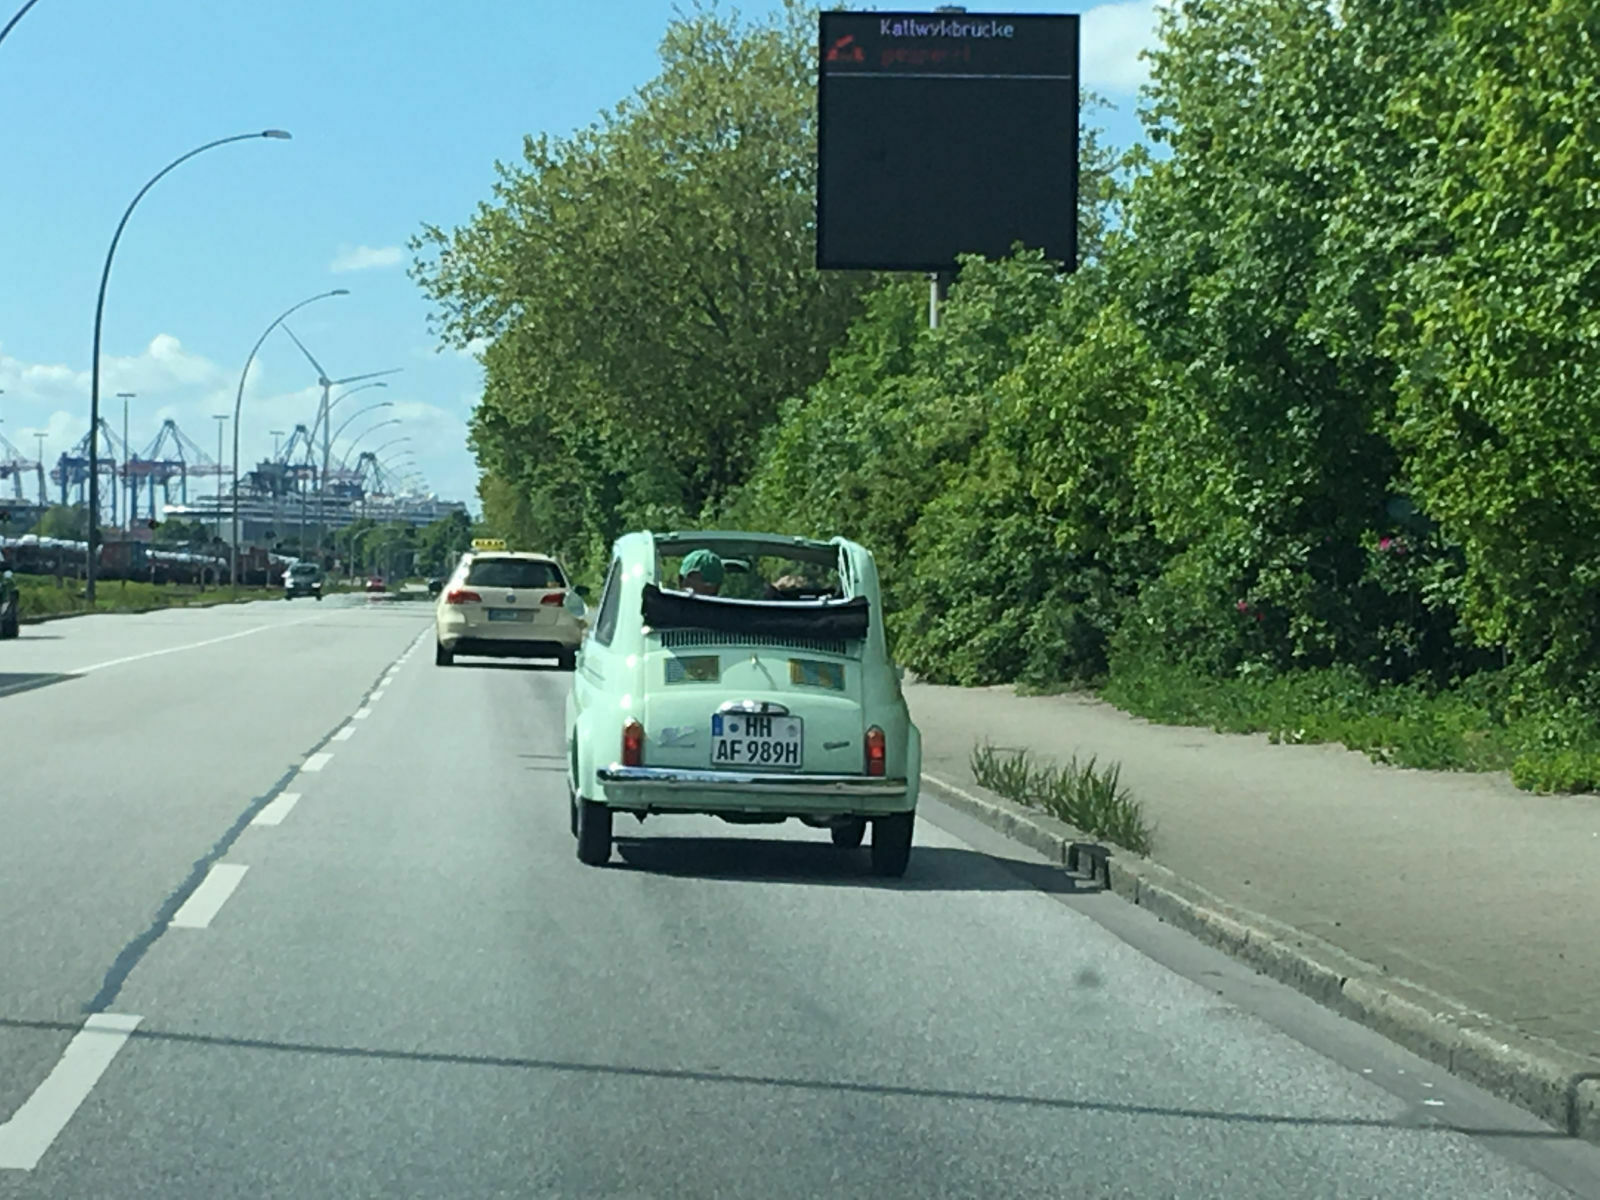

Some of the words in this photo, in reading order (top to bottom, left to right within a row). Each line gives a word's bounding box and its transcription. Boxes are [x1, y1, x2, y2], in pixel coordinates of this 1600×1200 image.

[745, 717, 772, 738] HH
[716, 739, 743, 761] AF
[747, 740, 798, 764] 989H
